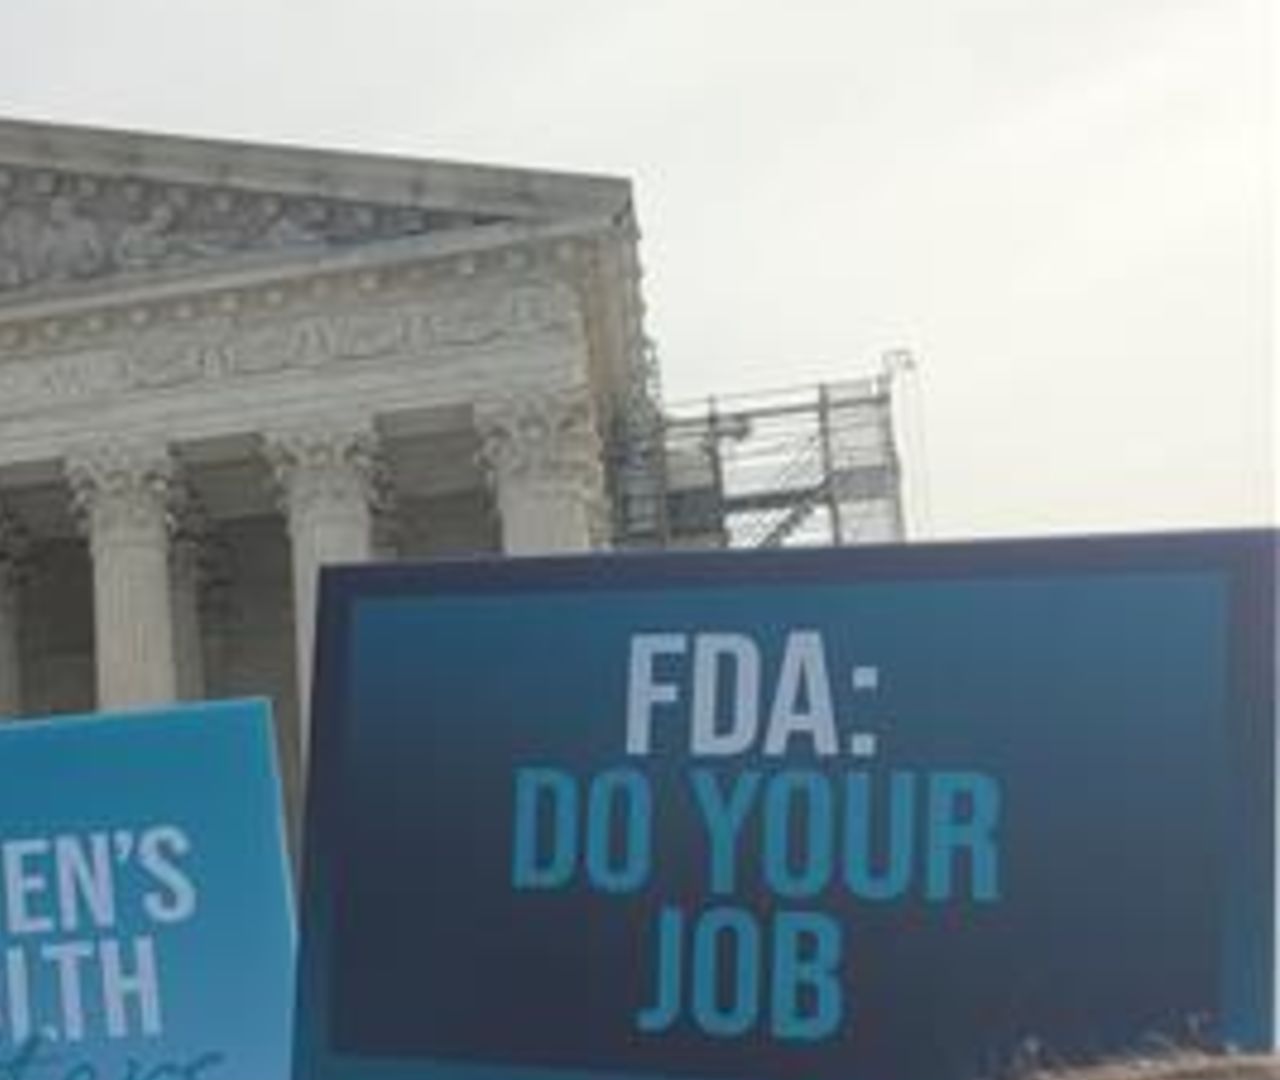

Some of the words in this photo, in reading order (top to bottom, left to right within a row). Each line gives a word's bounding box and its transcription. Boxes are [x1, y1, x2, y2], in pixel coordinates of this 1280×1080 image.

[625, 629, 878, 758] FDA:
[512, 768, 653, 890] DO
[690, 772, 1001, 903] YOUR
[635, 906, 845, 1040] JOB
